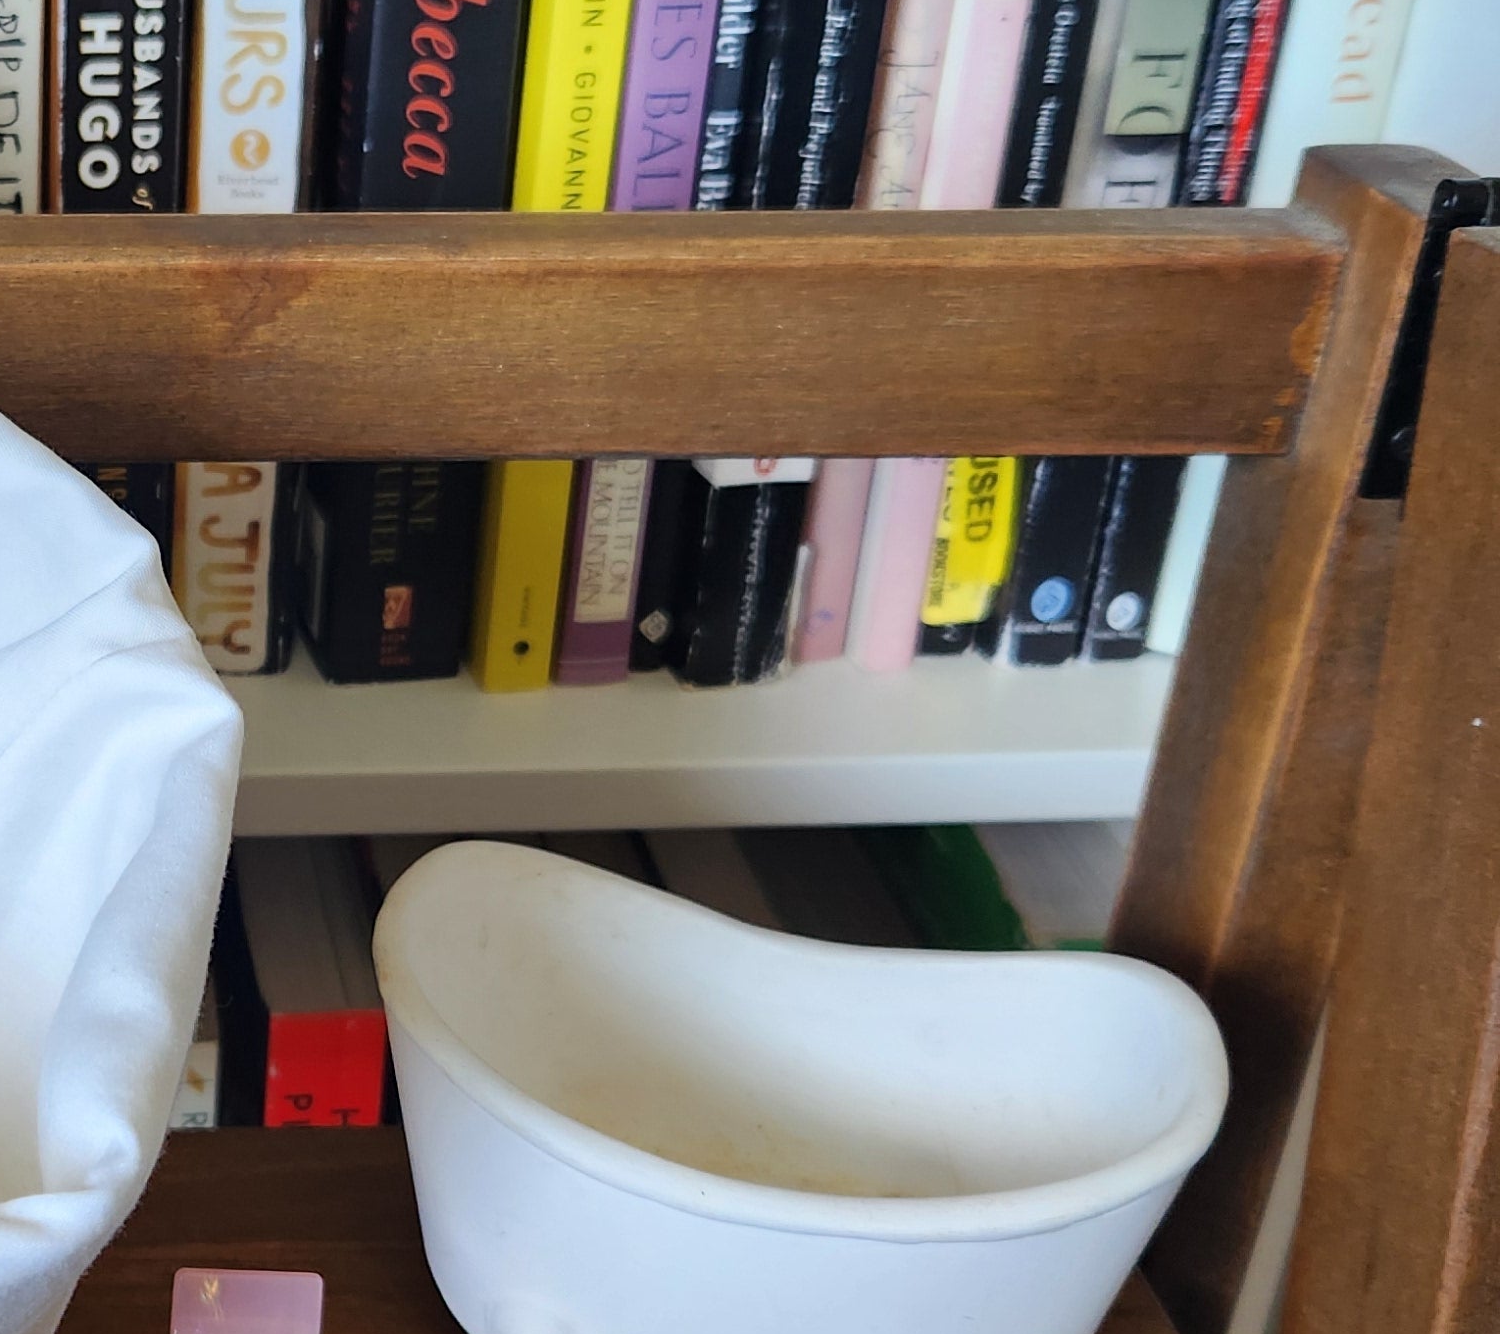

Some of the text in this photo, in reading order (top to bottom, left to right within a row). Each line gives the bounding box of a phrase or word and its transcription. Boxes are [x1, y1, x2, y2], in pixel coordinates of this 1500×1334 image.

[817, 12, 850, 71] Pride
[78, 14, 124, 190] HUGO
[810, 73, 837, 113] and
[700, 110, 742, 171] Eva
[131, 187, 153, 210] of
[569, 482, 604, 607] MOUNTAIN
[607, 480, 640, 596] TELL IT ON
[199, 514, 262, 656] JULY
